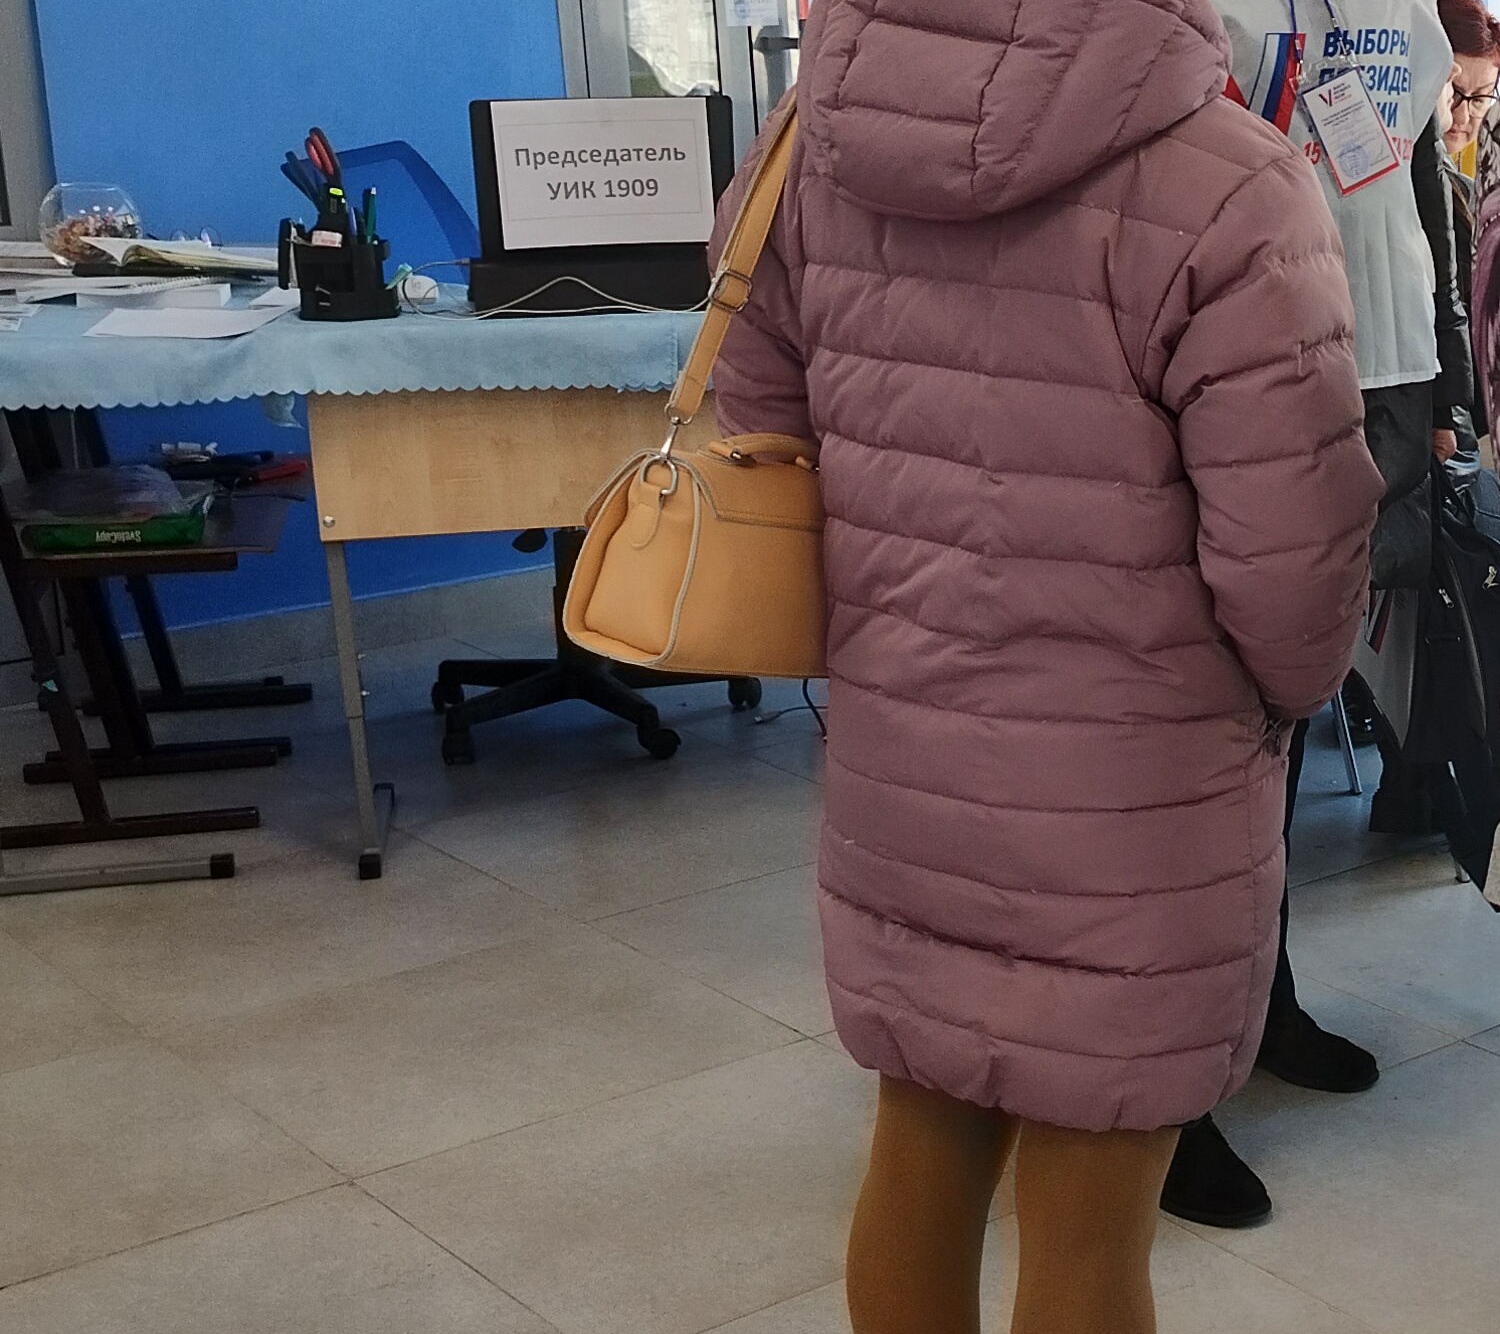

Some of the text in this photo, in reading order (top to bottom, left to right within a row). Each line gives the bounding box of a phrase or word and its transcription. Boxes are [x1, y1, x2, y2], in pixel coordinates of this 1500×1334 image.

[1323, 28, 1410, 58] ВЫБОРЫ
[514, 147, 686, 169] Председатель
[547, 178, 658, 200] УИК 1909
